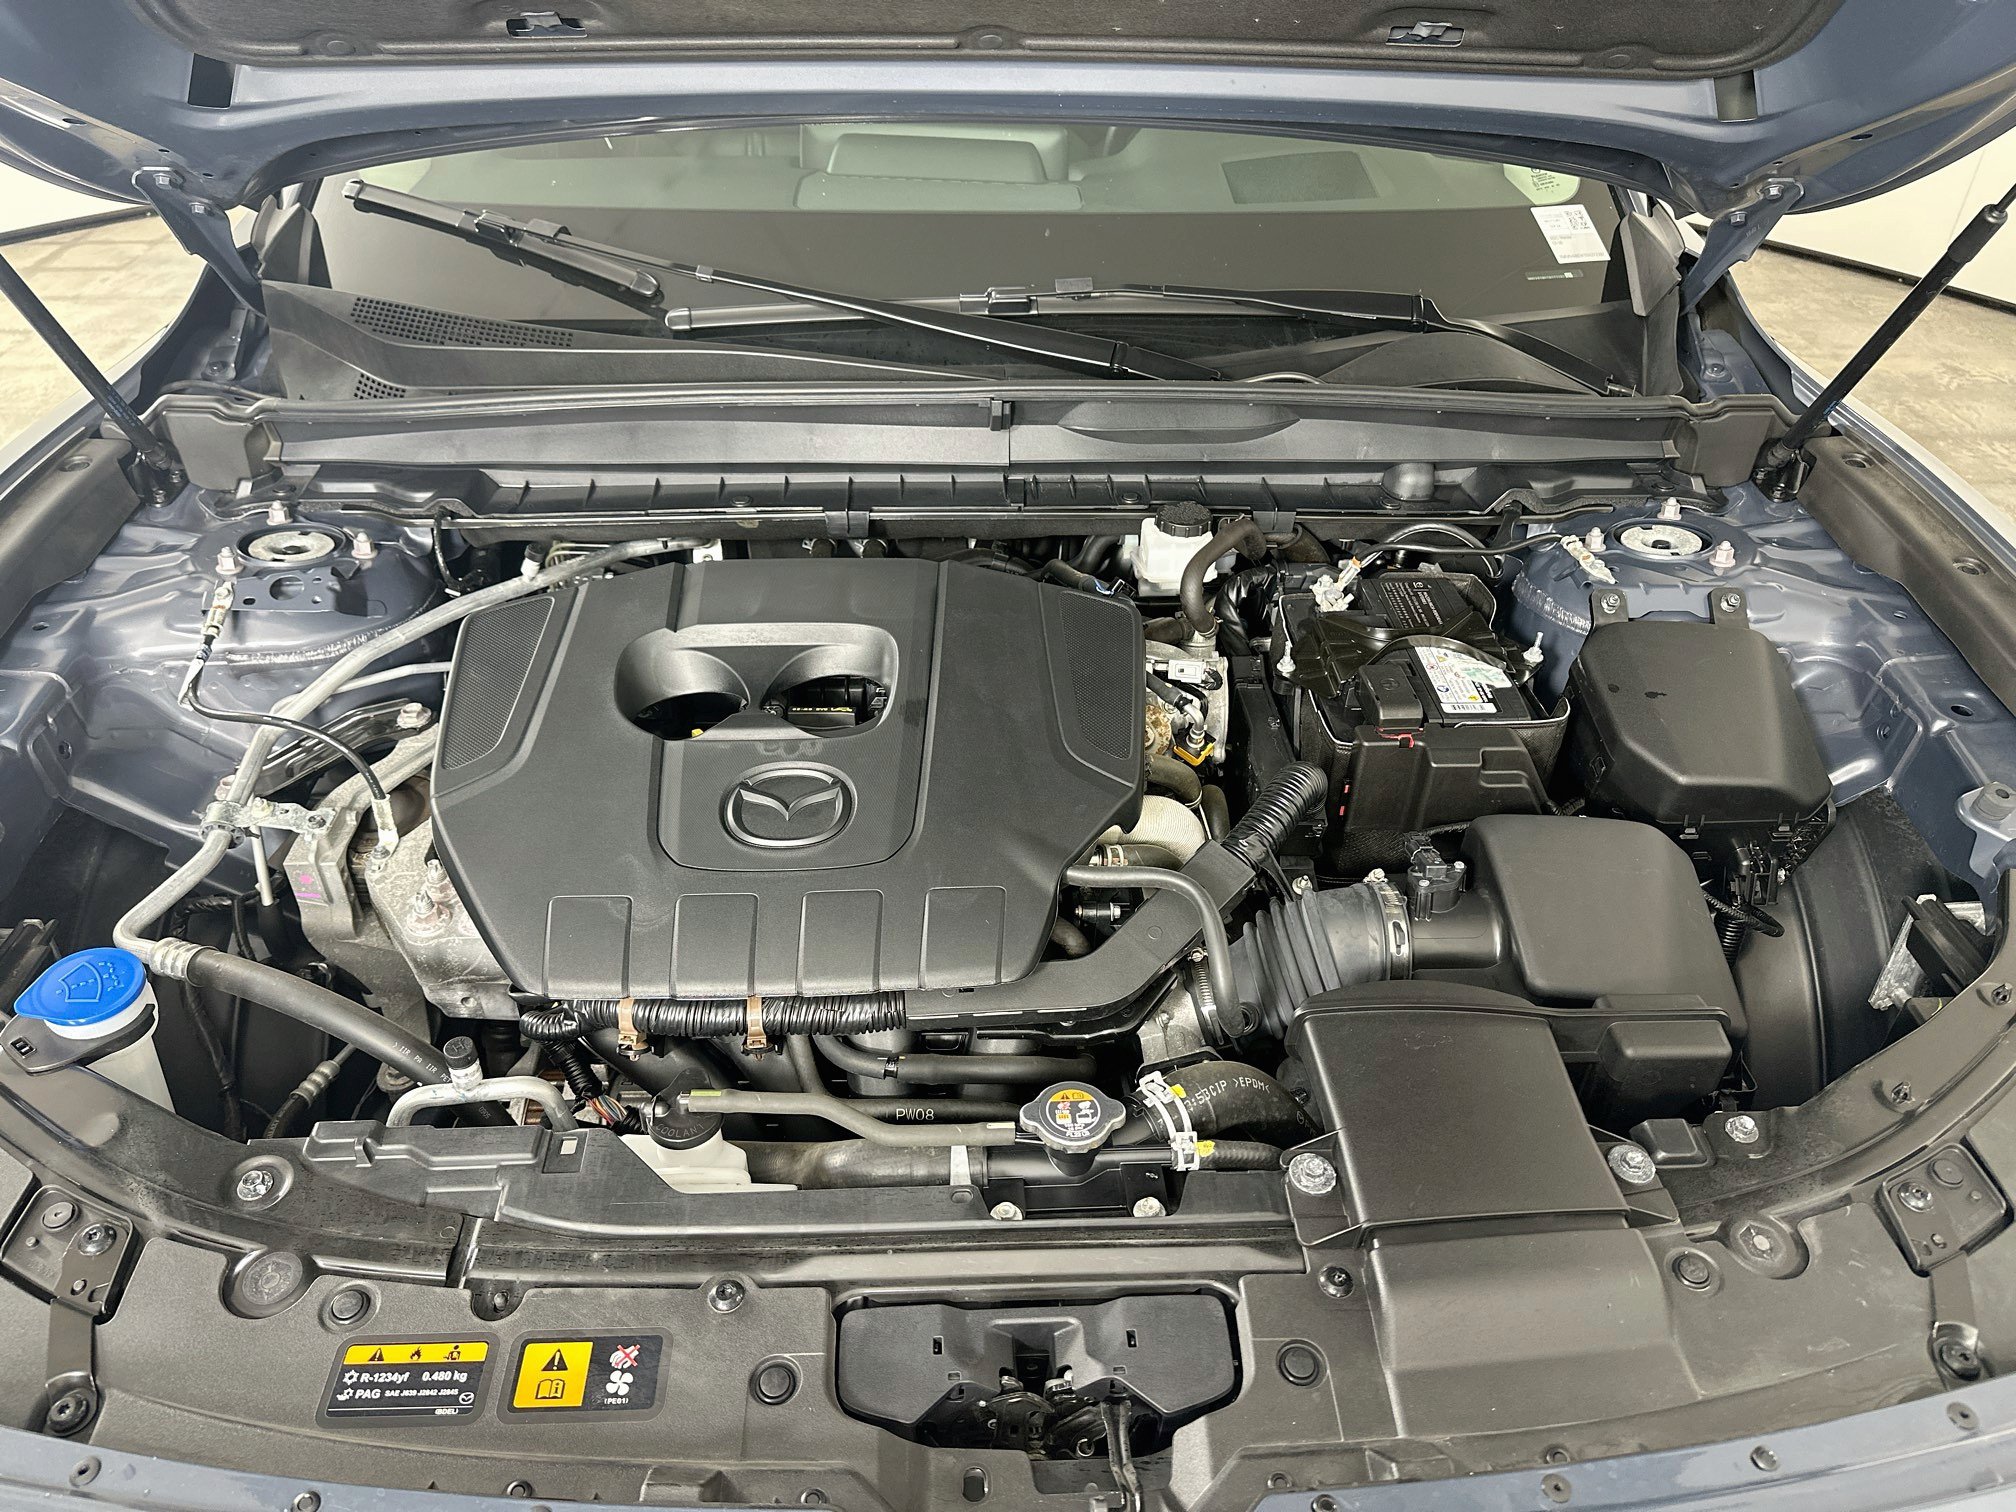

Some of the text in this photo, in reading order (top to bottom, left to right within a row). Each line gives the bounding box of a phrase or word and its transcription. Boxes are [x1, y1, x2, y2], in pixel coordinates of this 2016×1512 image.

[1233, 1076, 1271, 1094] >EPDM<
[896, 1108, 934, 1120] PW08
[656, 1123, 705, 1138] COOLANT
[360, 1370, 468, 1384] R-1234yf 0.480 kg
[355, 1389, 381, 1399] PAG
